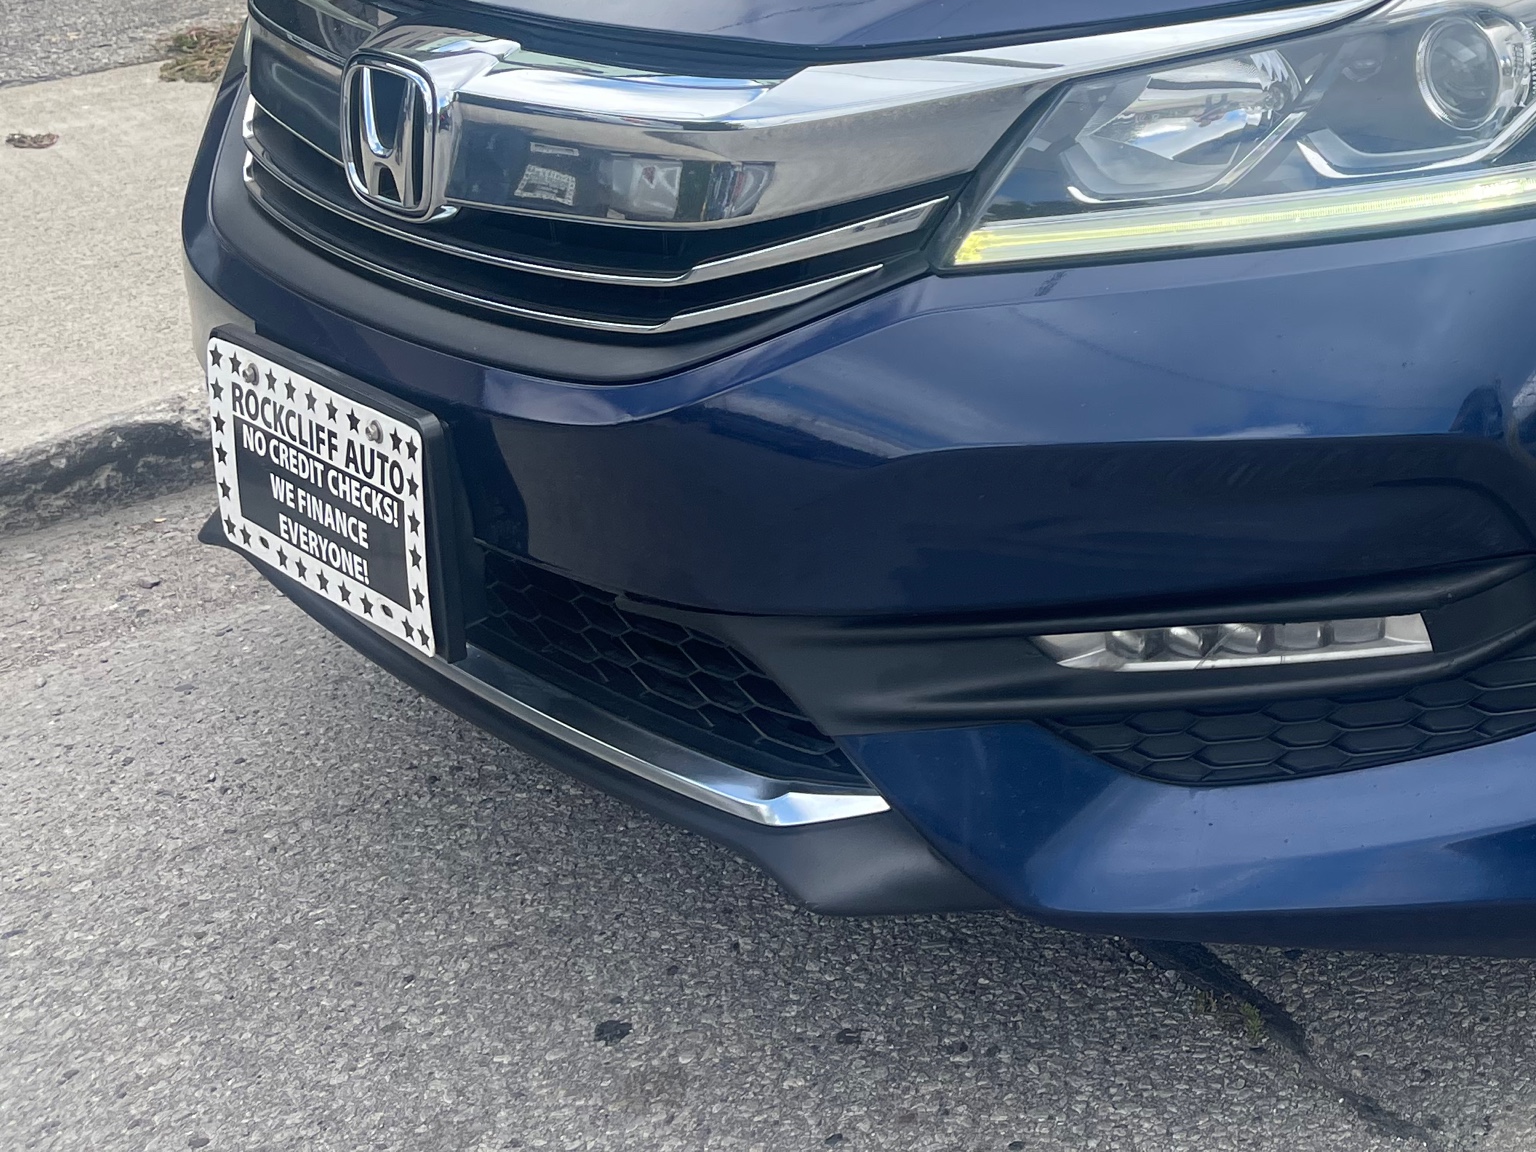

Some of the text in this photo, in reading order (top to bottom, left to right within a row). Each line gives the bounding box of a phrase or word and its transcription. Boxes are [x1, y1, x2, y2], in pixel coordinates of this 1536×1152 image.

[231, 381, 405, 495] ROCKCLIFF AUTO
[242, 423, 399, 529] NO CREDIT CHECKS!
[269, 472, 369, 549] WE FINANCE
[278, 512, 370, 585] EVERYONE!
